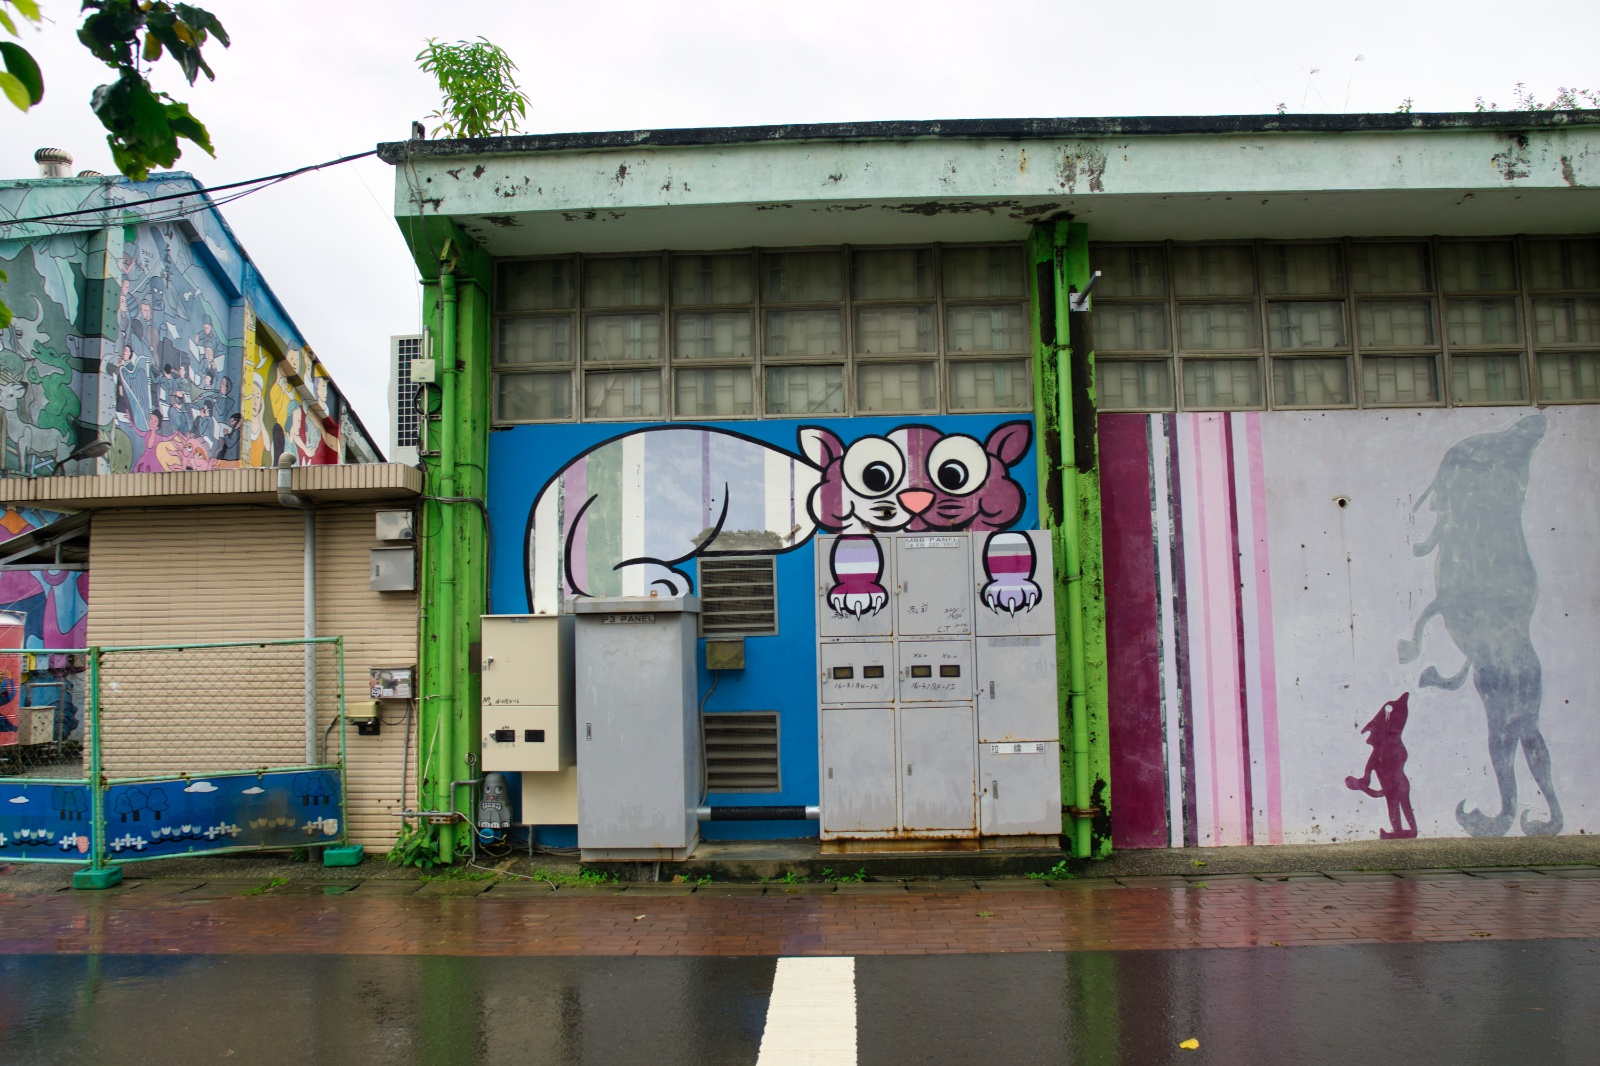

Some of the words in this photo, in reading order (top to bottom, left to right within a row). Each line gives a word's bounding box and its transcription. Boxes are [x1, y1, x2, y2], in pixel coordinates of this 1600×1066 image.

[602, 614, 616, 623] P3
[620, 614, 654, 623] PANEL
[991, 744, 1043, 753] 拉線箱
